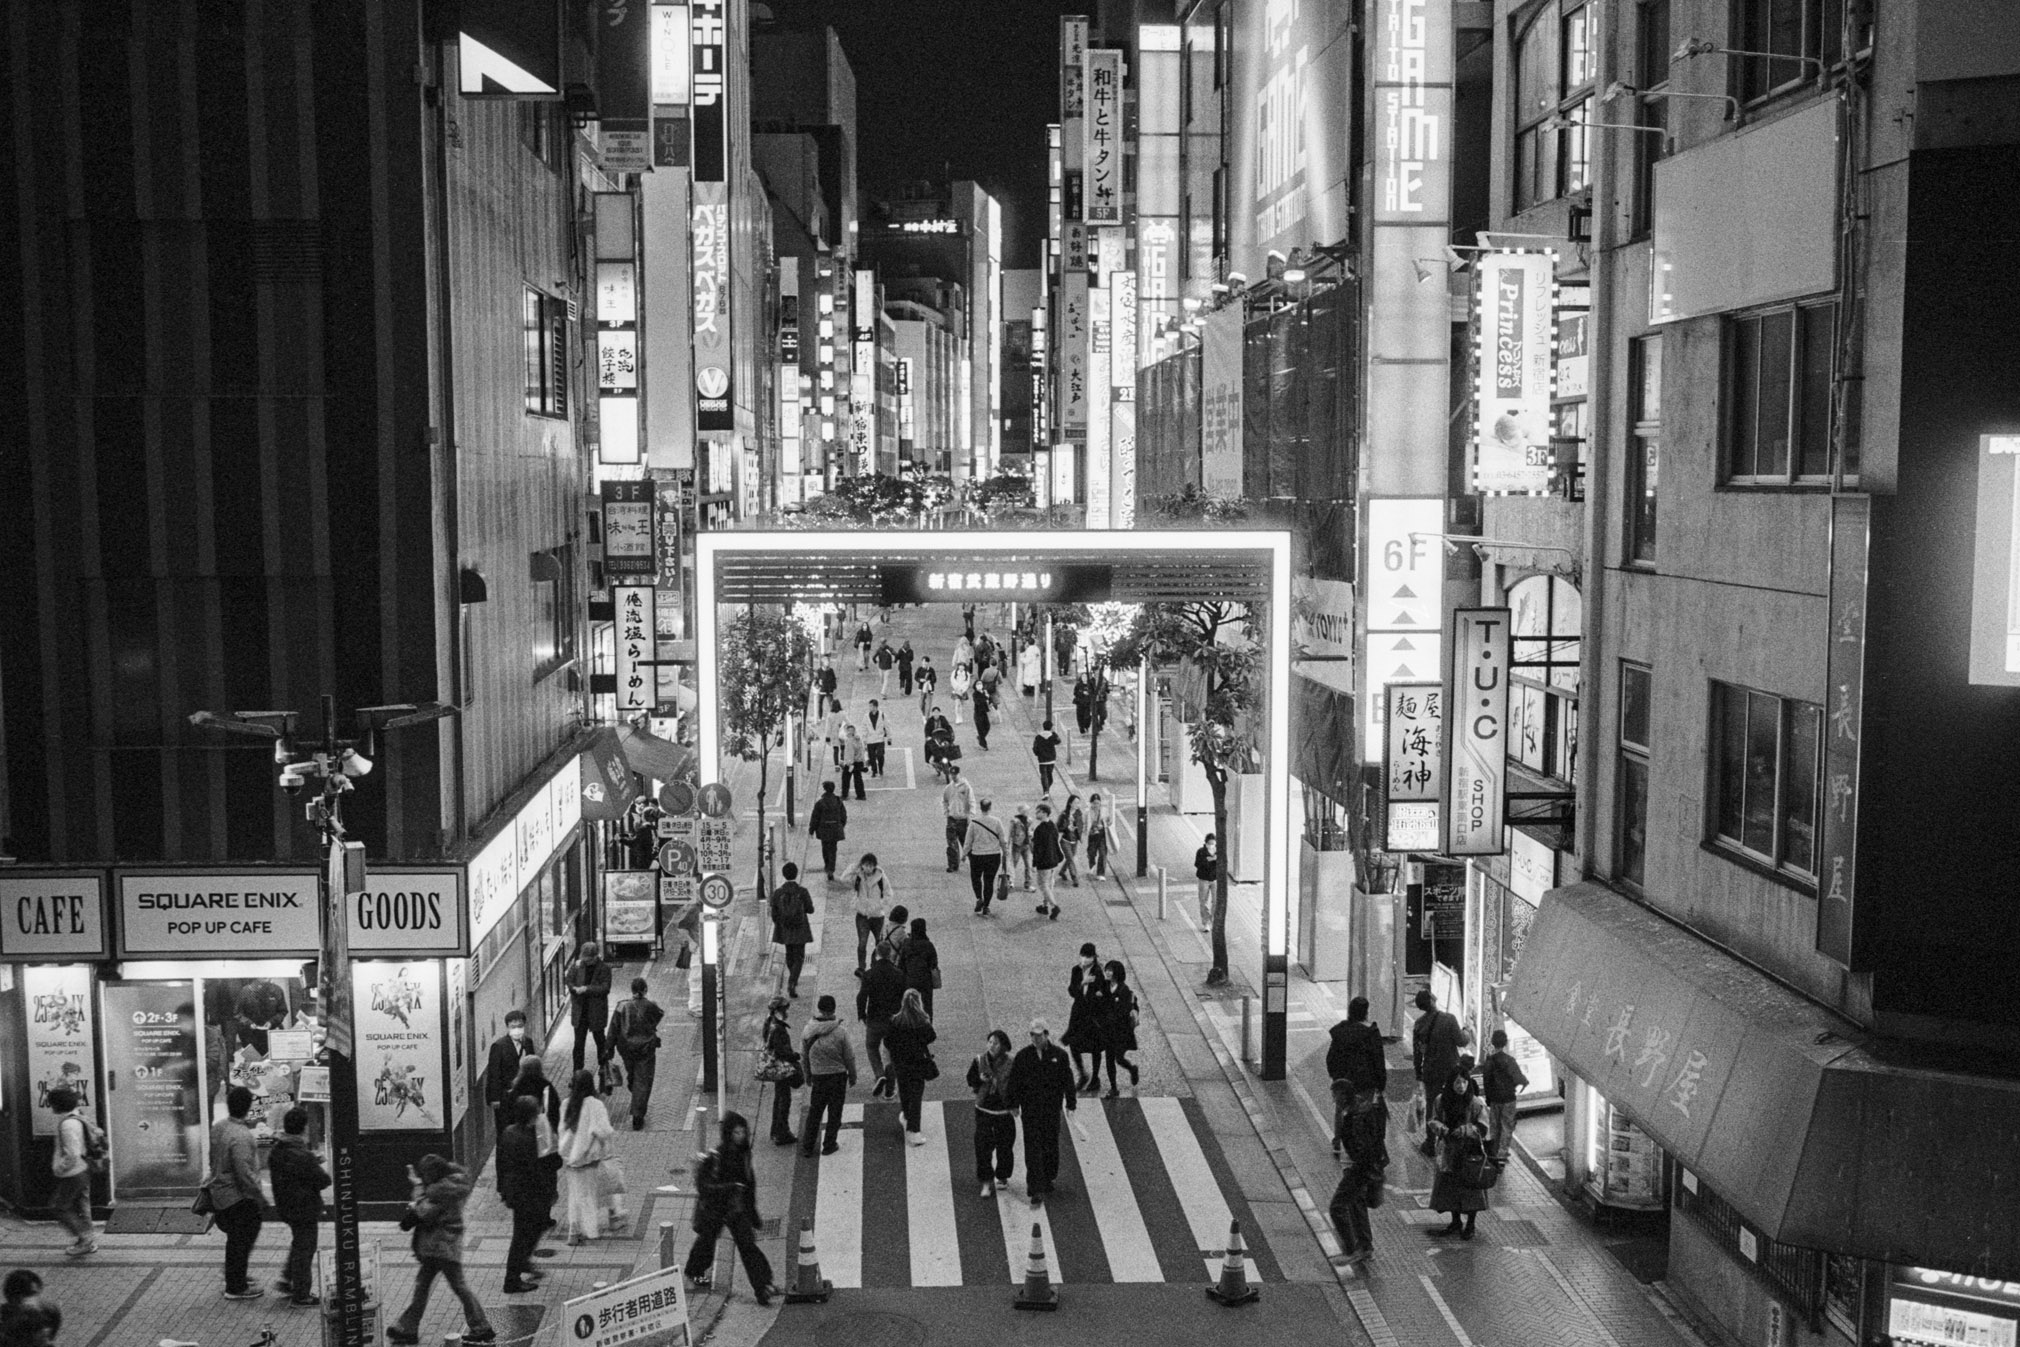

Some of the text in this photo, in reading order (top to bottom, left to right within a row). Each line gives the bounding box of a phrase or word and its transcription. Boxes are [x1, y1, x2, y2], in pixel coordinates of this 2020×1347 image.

[1096, 208, 1110, 219] 5F
[694, 204, 717, 333] ベガスベガス
[1498, 282, 1519, 390] Princess
[1070, 368, 1083, 404] 大江戸
[1527, 446, 1547, 465] 3F
[1383, 539, 1426, 572] 6F
[624, 591, 646, 706] 俺流塩らーめん
[1394, 692, 1442, 720] 麺屋
[1391, 760, 1400, 793] らーめん
[1401, 725, 1433, 795] 海神
[1471, 779, 1484, 832] SHOP
[667, 849, 681, 871] P
[138, 892, 239, 911] SQUARE
[707, 884, 726, 900] 30
[17, 895, 85, 935] CAFE
[168, 921, 272, 934] POP UP CAFE
[357, 891, 442, 931] GOODS
[365, 1033, 406, 1041] SQUARE
[150, 1067, 163, 1077] 1F
[1605, 1004, 1708, 1119] 長野屋
[339, 1155, 355, 1250] SHINJUKU
[598, 1286, 677, 1329] 歩行者用道路
